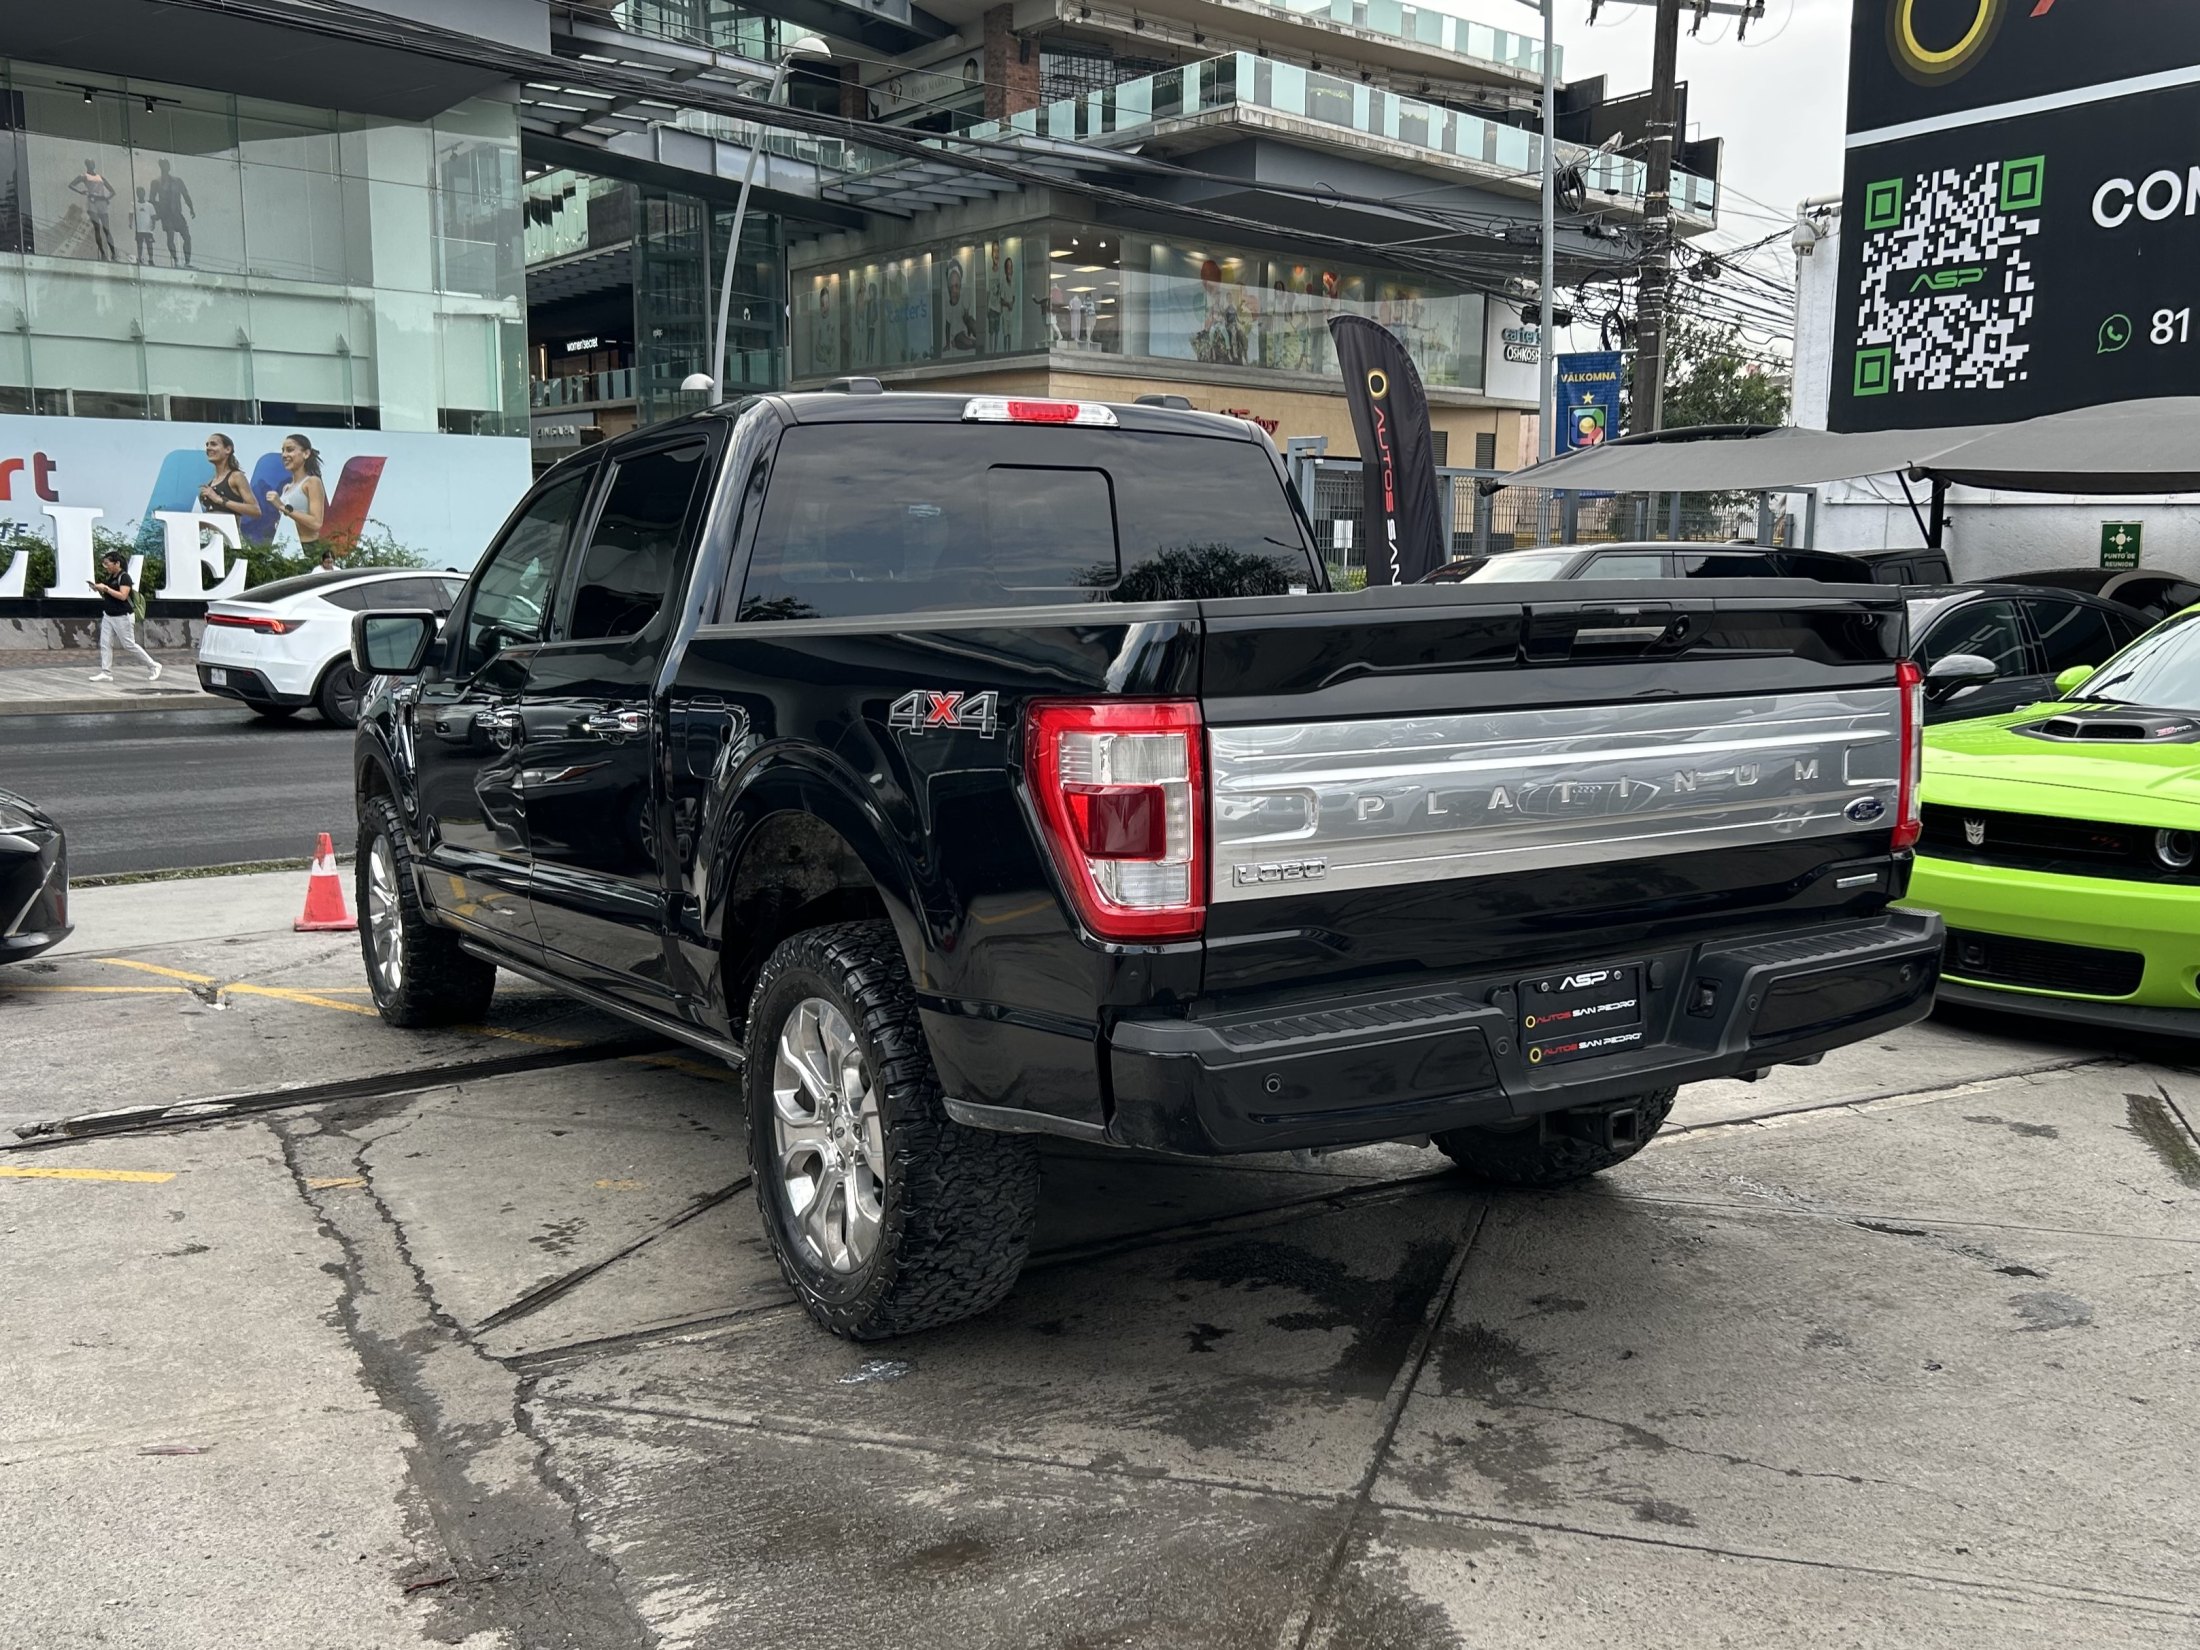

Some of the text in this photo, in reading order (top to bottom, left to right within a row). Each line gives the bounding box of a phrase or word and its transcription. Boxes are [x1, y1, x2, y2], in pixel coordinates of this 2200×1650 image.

[1909, 267, 1984, 293] ASP
[2150, 307, 2191, 345] 81
[1373, 404, 1402, 586] AUTOS SAN
[0, 504, 249, 600] LE
[1357, 759, 1819, 821] PLATINUM
[1854, 802, 1882, 819] Ford
[1237, 860, 1326, 884] LOBO
[1560, 969, 1608, 991] ASP
[1536, 999, 1636, 1024] AUTOS SAN PEDRO
[1543, 1032, 1641, 1056] AUTOS SAN PEDRO
